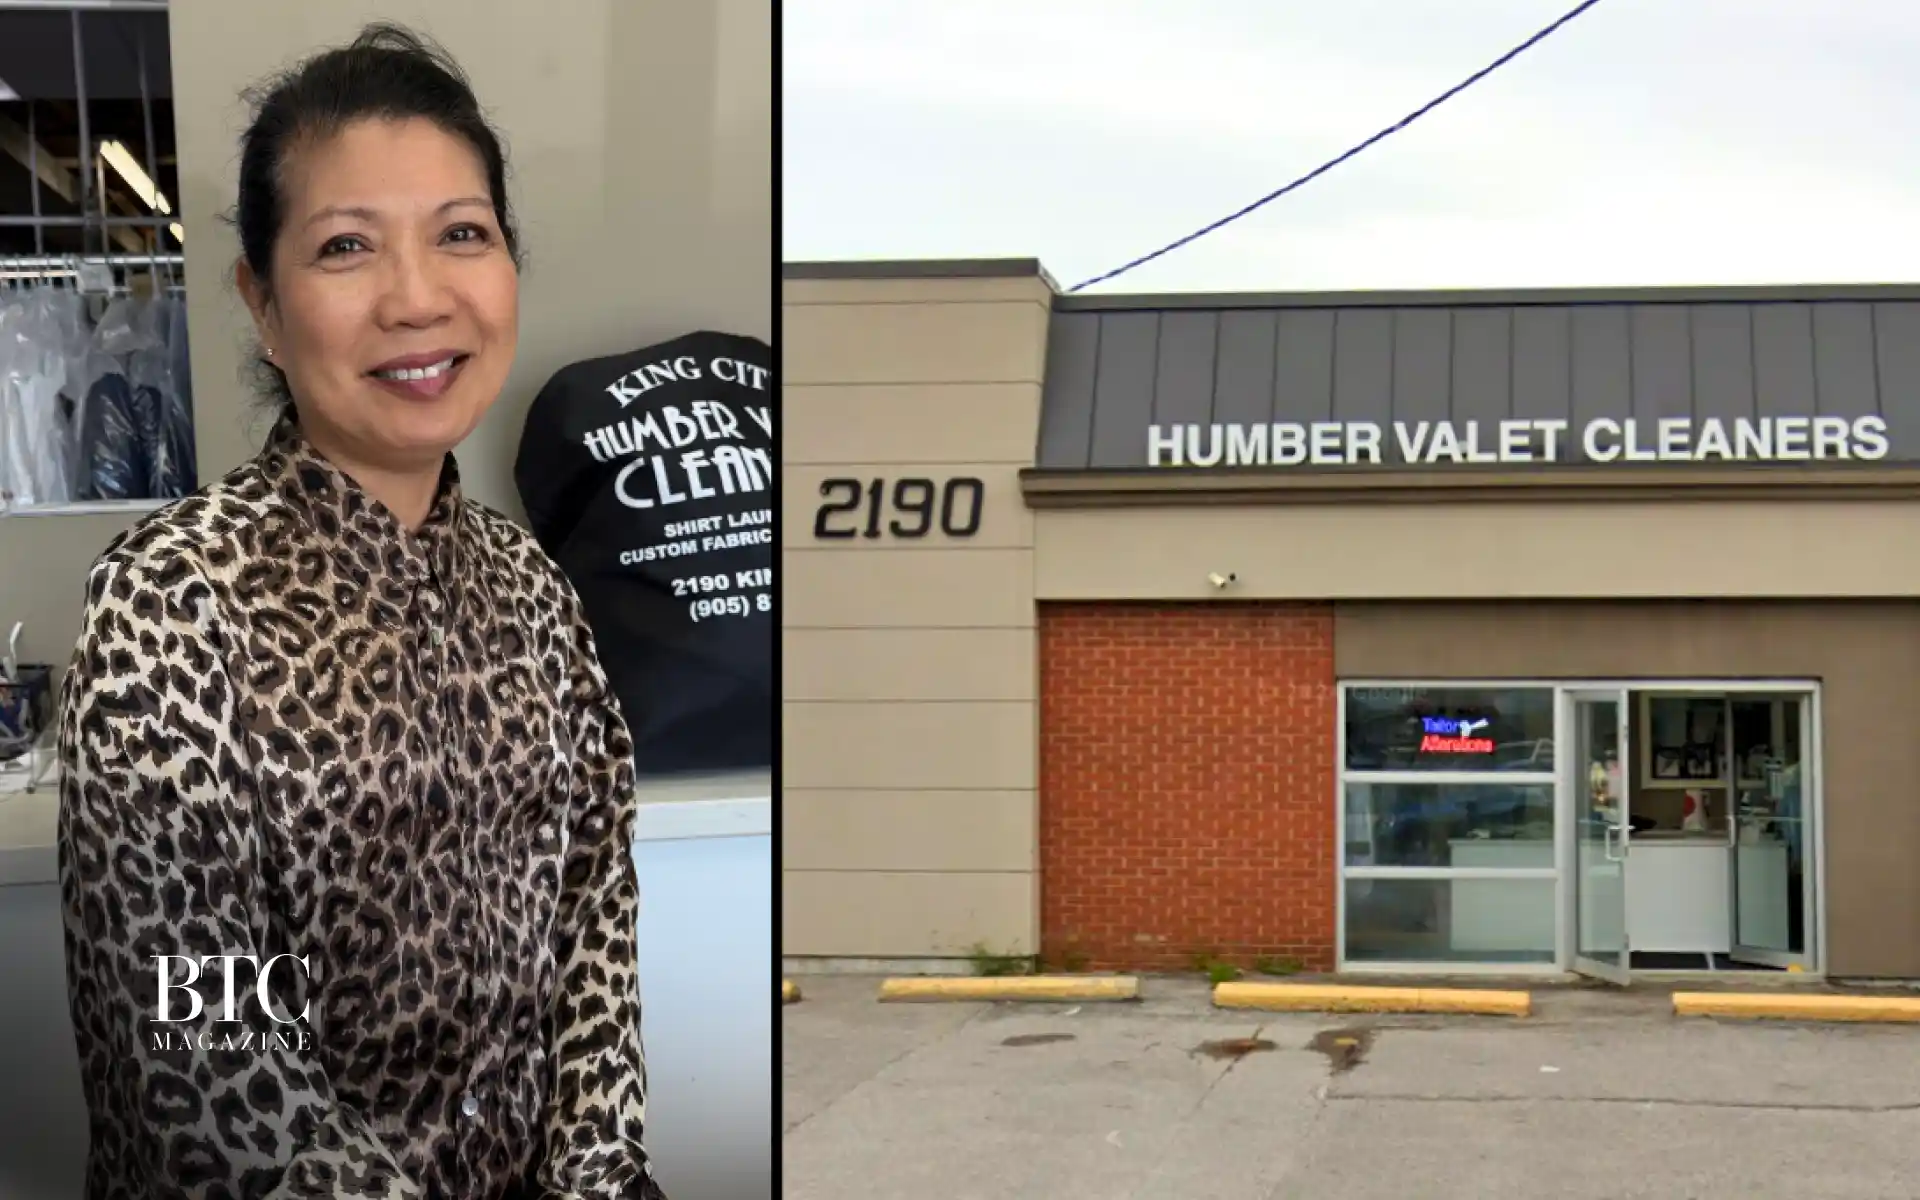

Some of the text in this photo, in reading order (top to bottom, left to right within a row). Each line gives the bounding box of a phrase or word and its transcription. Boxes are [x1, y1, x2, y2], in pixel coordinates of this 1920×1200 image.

[604, 356, 771, 408] KING CIT
[583, 400, 745, 462] HUMBER
[1147, 415, 1890, 467] HUMBER VALET CLEANERS
[663, 515, 723, 538] SHIRT
[813, 476, 985, 539] 2190
[619, 528, 771, 566] CUSTOM FABRIC
[671, 573, 730, 597] 2190
[689, 593, 771, 623] (905) 8
